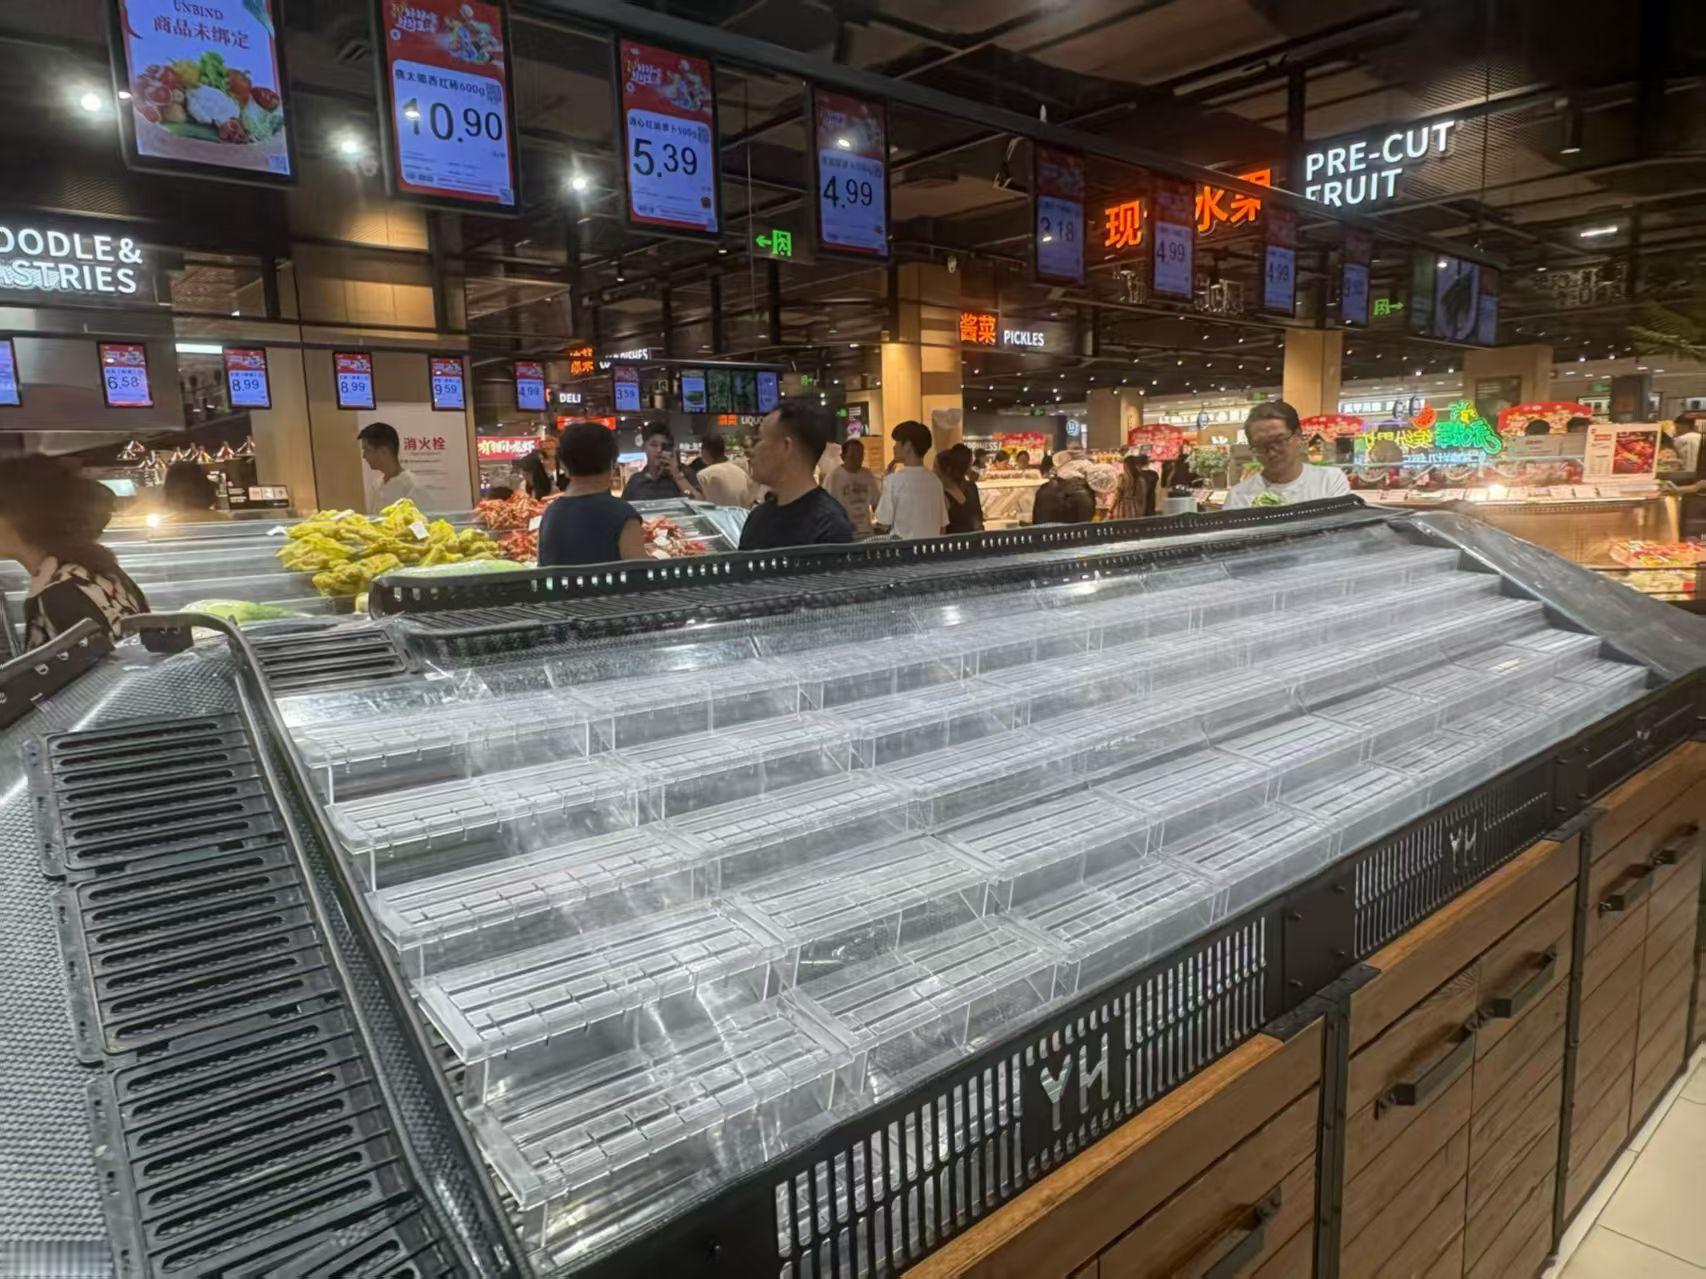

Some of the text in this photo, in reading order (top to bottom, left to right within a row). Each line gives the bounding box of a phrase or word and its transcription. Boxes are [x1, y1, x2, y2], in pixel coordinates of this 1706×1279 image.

[153, 15, 249, 49] 商品未绑定
[402, 97, 503, 143] 10.90
[633, 138, 697, 178] 5.39
[1305, 120, 1456, 181] PRE-CUT
[823, 176, 873, 208] 4.99
[1305, 168, 1403, 208] FRUIT
[1104, 167, 1271, 249] 现水果
[1156, 239, 1186, 263] 4.99
[960, 312, 996, 343] 酱菜
[1003, 329, 1044, 346] PICKLES
[108, 376, 140, 390] 6.58
[232, 379, 260, 393] 8.99
[341, 381, 366, 394] 8.99
[434, 384, 458, 396] 9.59
[560, 393, 581, 403] DELI
[404, 436, 446, 450] 消火栓
[1040, 1032, 1110, 1132] YH
